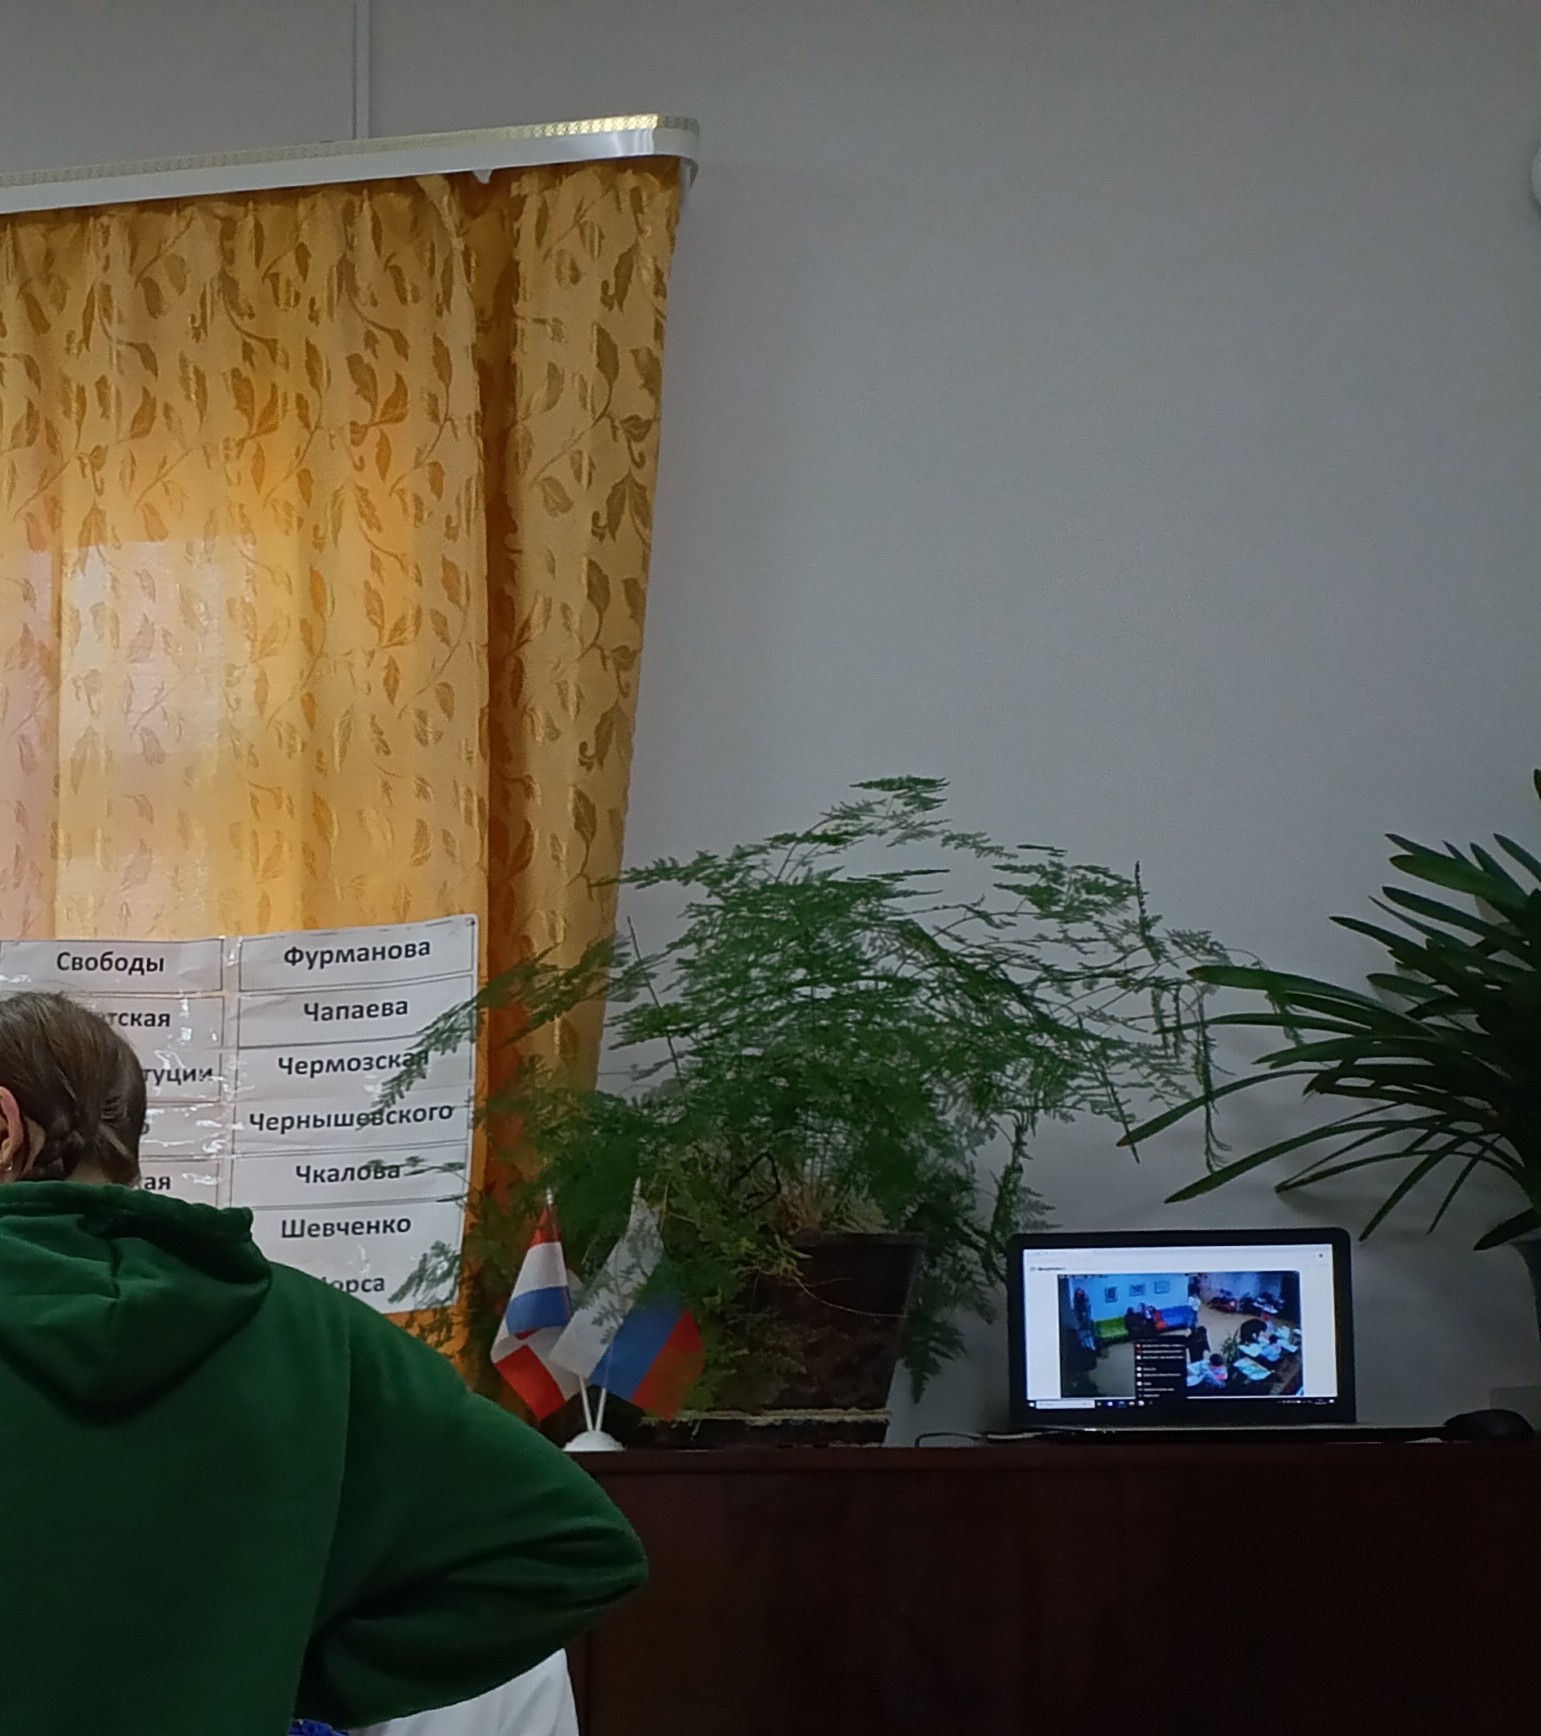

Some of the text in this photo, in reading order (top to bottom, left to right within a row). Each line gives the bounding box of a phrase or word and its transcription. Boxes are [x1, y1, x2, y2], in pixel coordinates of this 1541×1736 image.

[56, 950, 165, 976] Свободы
[283, 941, 431, 971] Фурманова
[303, 1000, 408, 1022] Чапаева
[276, 1048, 430, 1080] Чермозская
[248, 1103, 454, 1134] Чернышевского
[294, 1161, 401, 1187] Чкалова
[281, 1218, 412, 1239] Шевченко
[324, 1274, 386, 1297] орса
